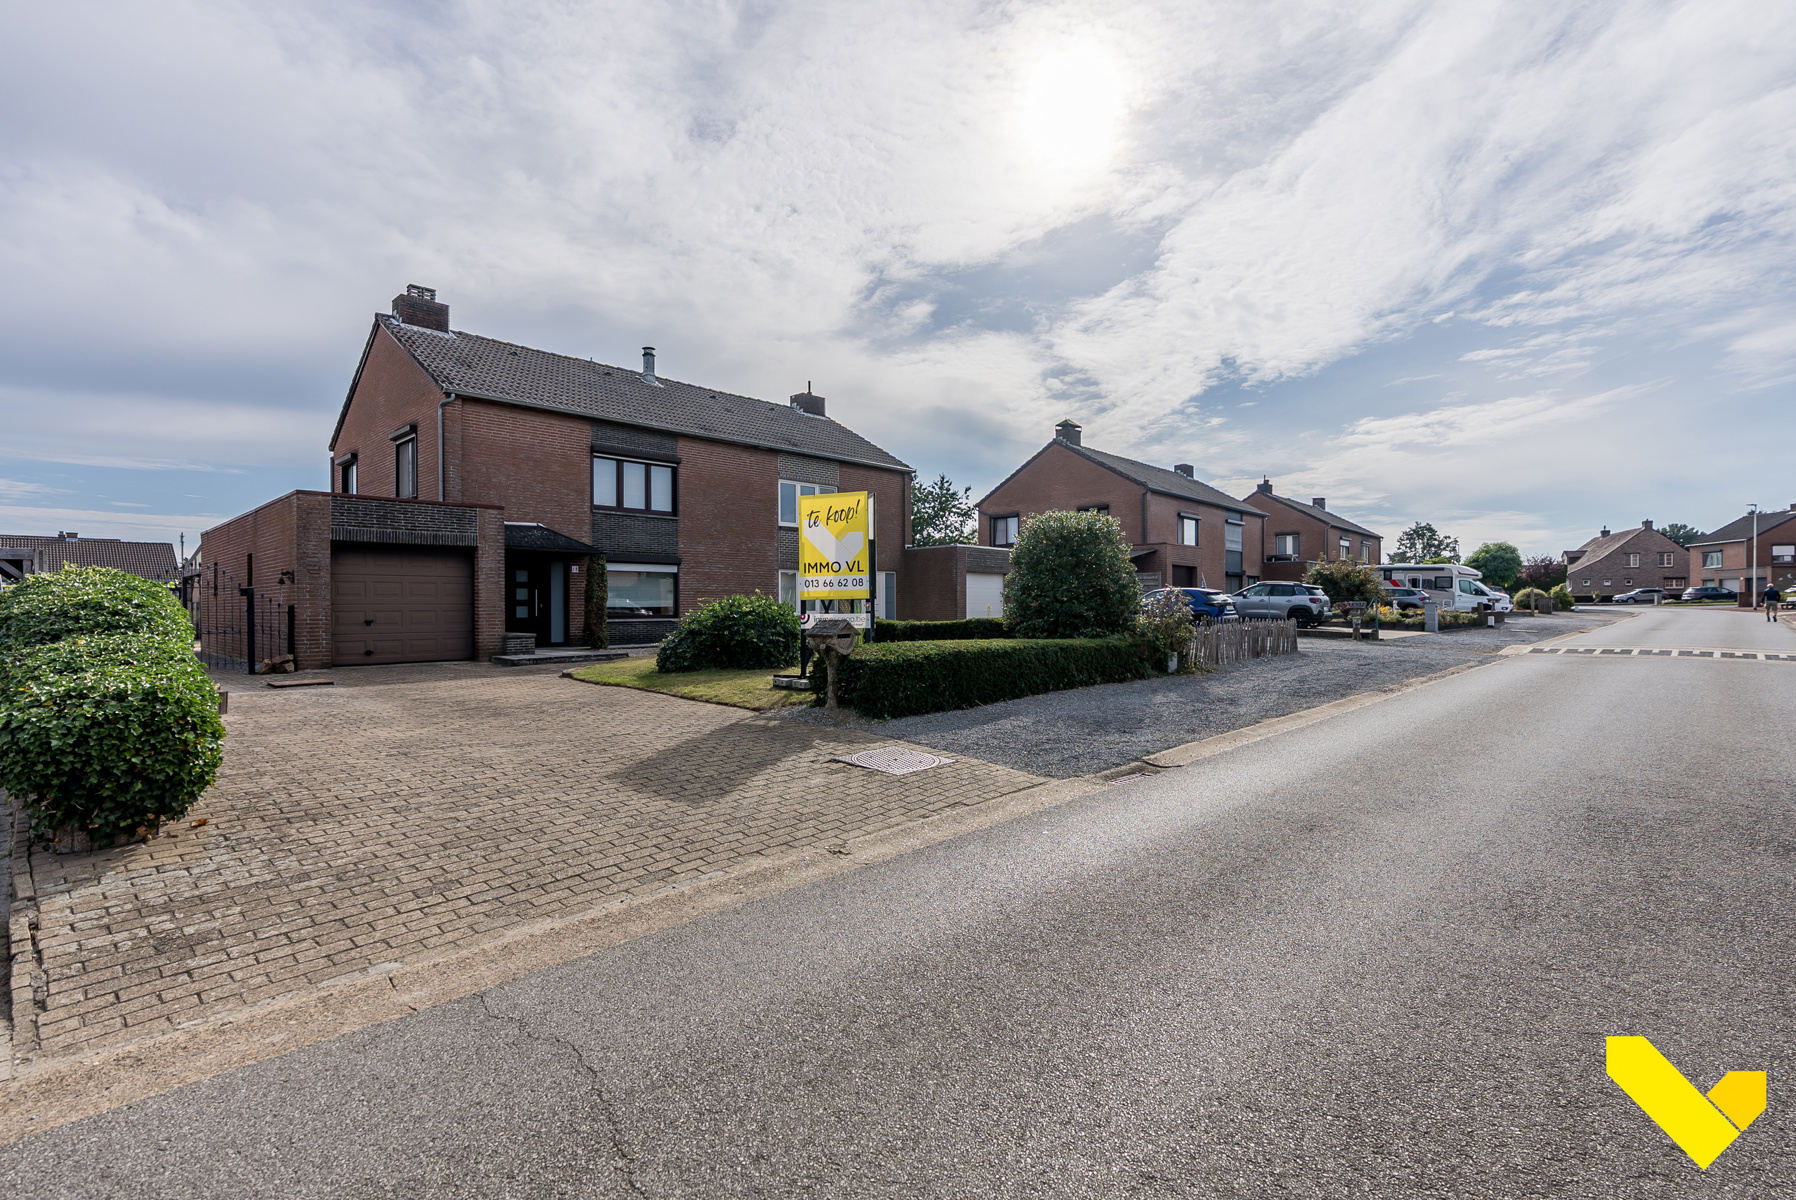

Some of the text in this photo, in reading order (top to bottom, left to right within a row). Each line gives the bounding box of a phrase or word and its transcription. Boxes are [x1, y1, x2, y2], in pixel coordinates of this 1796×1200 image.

[807, 499, 860, 529] te koop!
[803, 560, 865, 574] IMMO VL
[804, 577, 864, 588] 013 66 62 08
